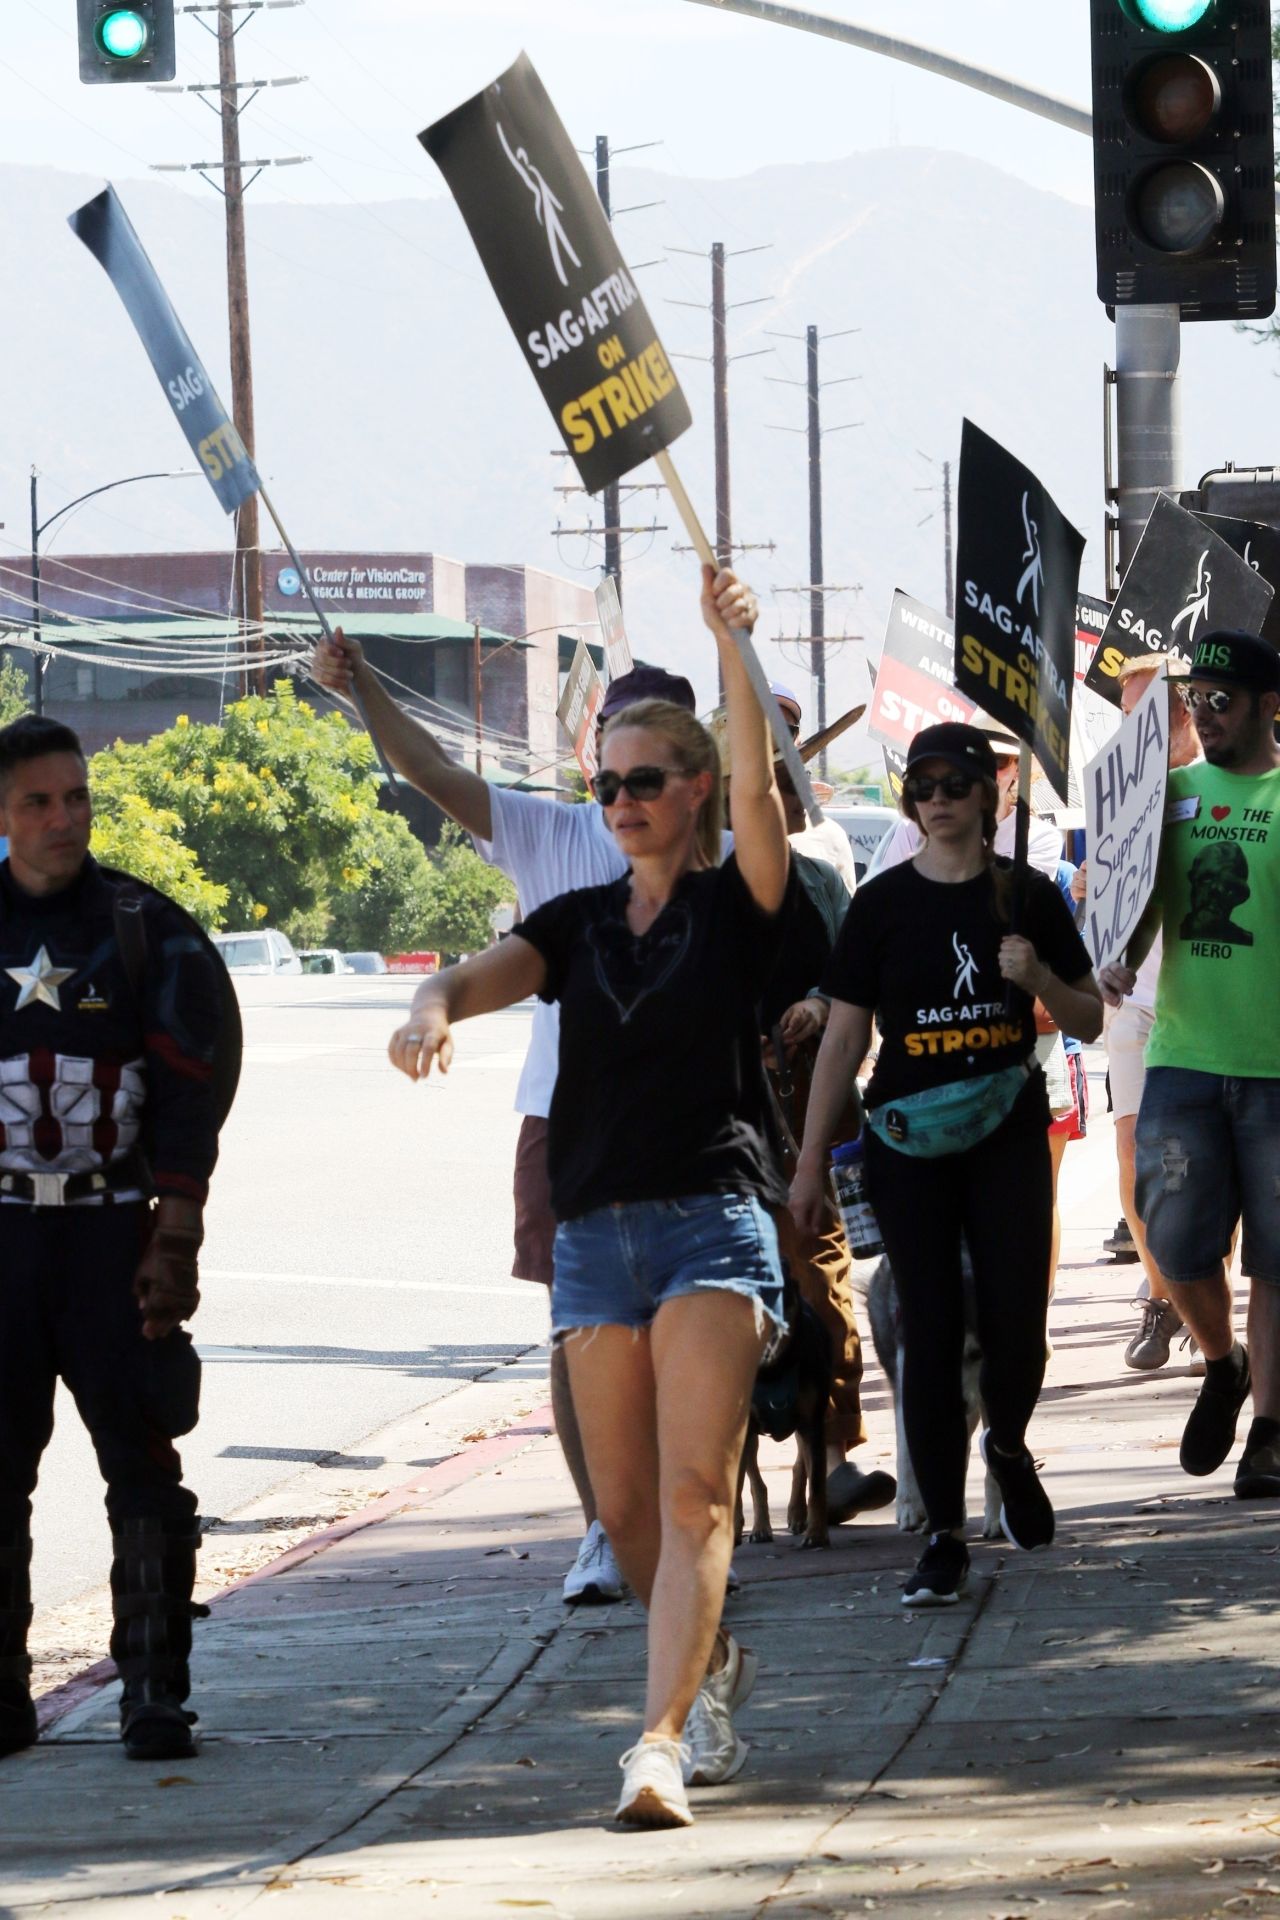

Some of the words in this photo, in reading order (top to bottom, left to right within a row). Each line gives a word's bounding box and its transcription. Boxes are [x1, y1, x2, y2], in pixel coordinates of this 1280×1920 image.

[597, 334, 626, 370] ON
[561, 339, 676, 454] STRIKE!
[313, 566, 349, 583] Center
[349, 567, 366, 585] for
[366, 567, 425, 583] VisionCare
[346, 586, 354, 599] &
[356, 587, 393, 599] MEDICAL
[395, 587, 426, 599] GROUP
[1016, 652, 1040, 686] ON
[937, 696, 965, 723] ON
[961, 633, 1067, 773] STRIKE!
[1095, 696, 1163, 838] HWA
[1242, 808, 1273, 824] THE
[1094, 779, 1162, 899] Supports
[1190, 825, 1268, 843] MONSTER
[1090, 832, 1154, 970] WGA
[1190, 941, 1232, 960] HERO
